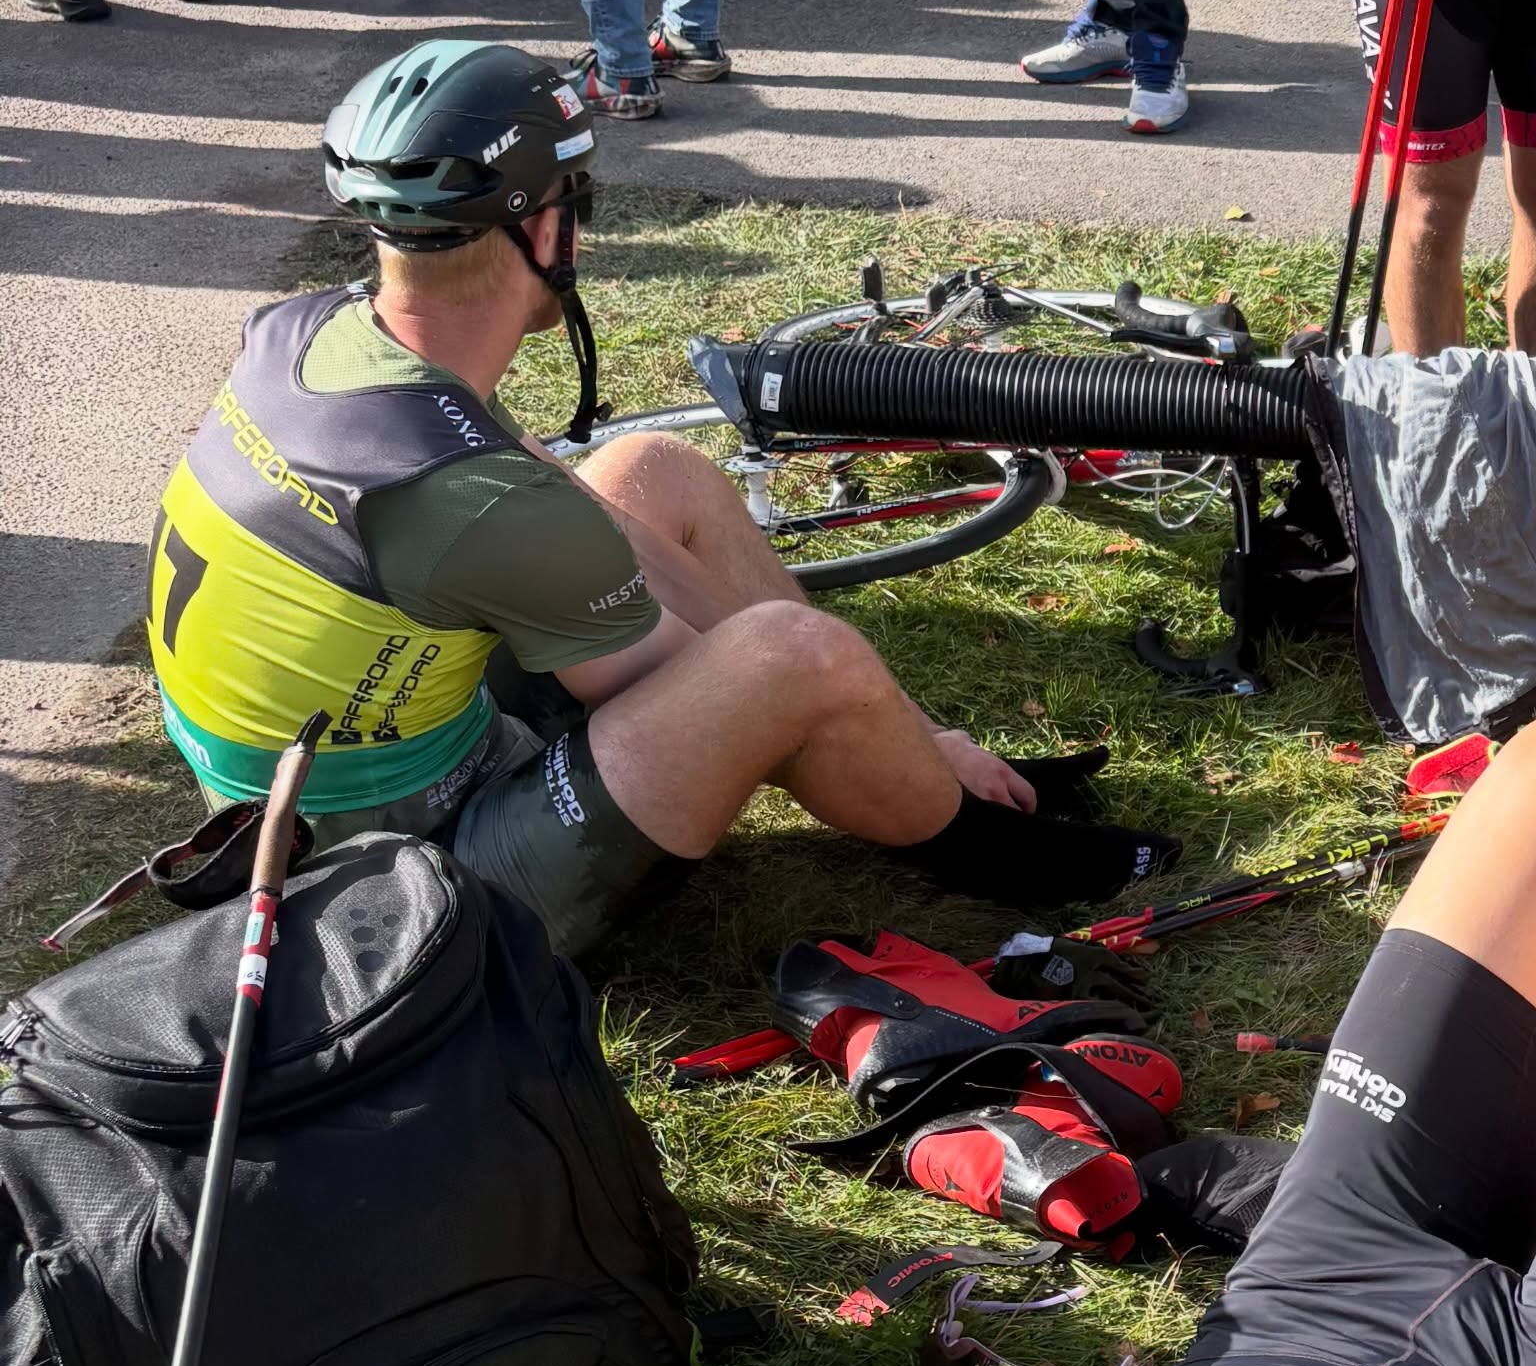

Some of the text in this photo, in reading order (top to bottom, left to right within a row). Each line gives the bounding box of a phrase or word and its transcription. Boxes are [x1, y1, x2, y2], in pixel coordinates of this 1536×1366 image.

[482, 125, 521, 165] HJC
[433, 394, 486, 447] KONG
[214, 380, 339, 527] SAFEROAD
[340, 634, 410, 732] AFEROAD
[552, 795, 573, 827] SKI
[1327, 833, 1389, 865] LEKI
[1175, 893, 1211, 912] HRC
[1075, 1043, 1154, 1069] ATOM
[1360, 1096, 1396, 1123] SKI
[887, 1251, 954, 1289] ATOMIC
